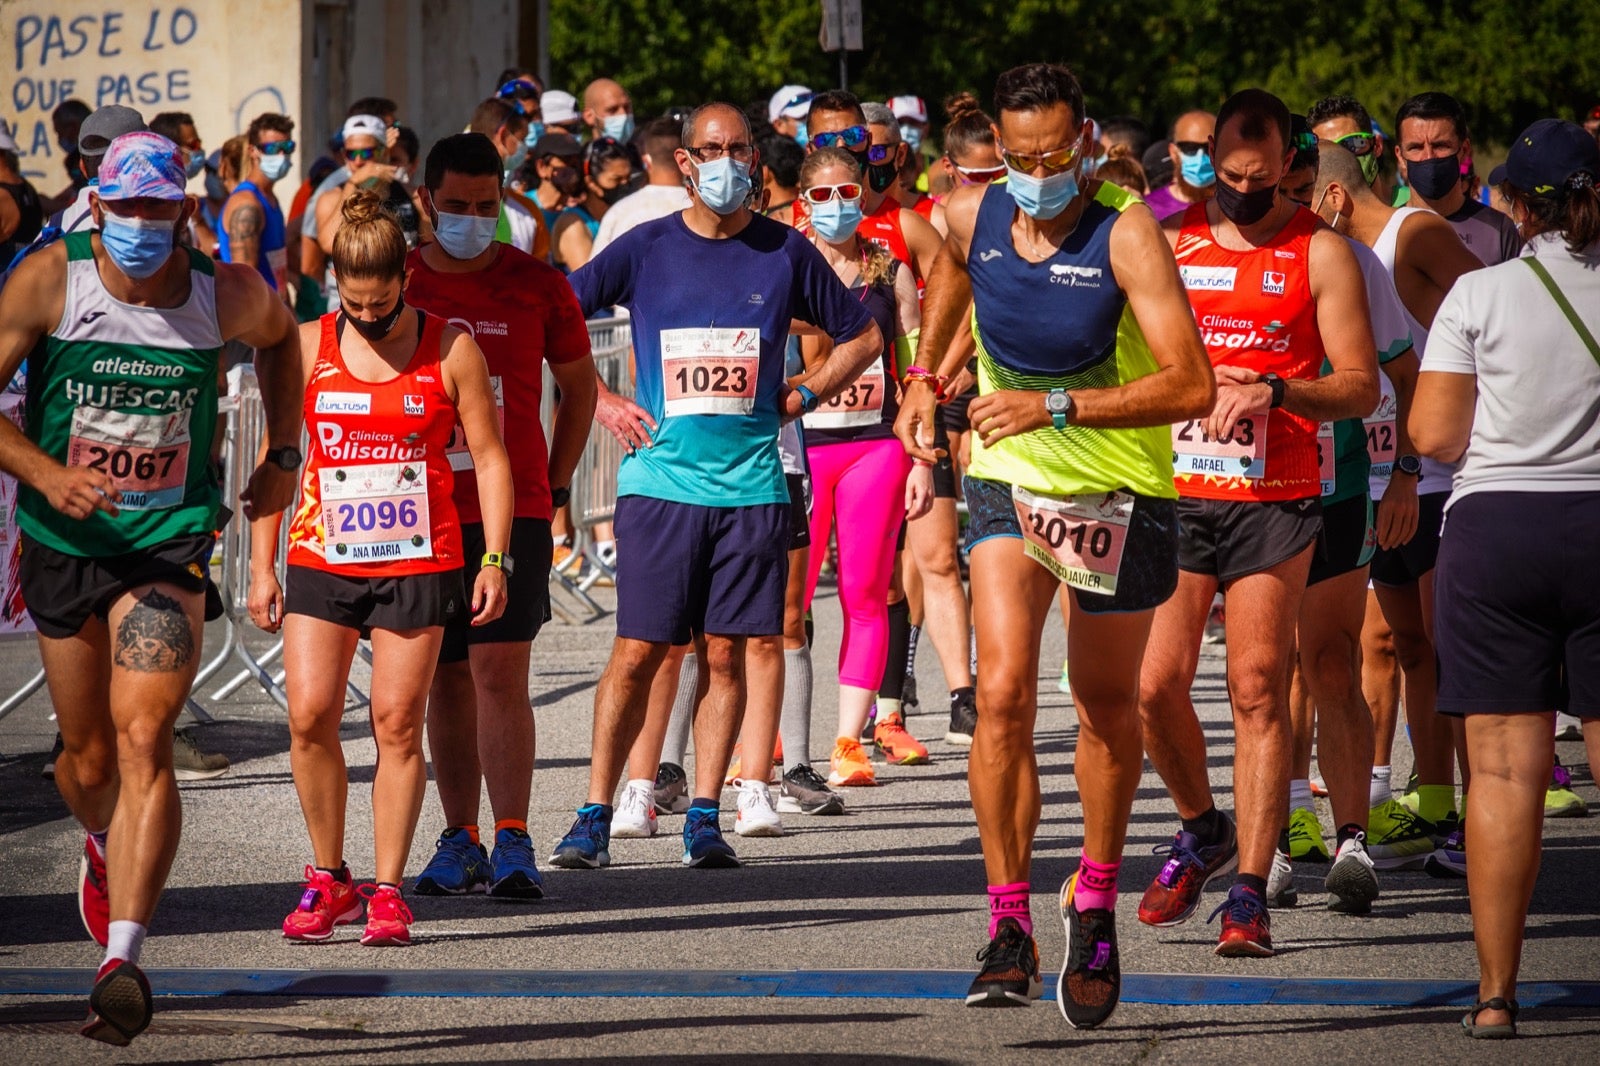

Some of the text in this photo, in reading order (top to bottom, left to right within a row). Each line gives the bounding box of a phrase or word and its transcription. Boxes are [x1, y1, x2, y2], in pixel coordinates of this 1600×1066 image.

[15, 8, 197, 71] PASE LO
[96, 70, 191, 107] PASE
[1050, 275, 1070, 286] CFM
[1263, 284, 1284, 293] MOVE
[1202, 315, 1253, 329] Clínicas
[1199, 327, 1291, 352] lisalud
[92, 356, 184, 378] atletismo
[676, 366, 747, 393] 1023
[66, 378, 199, 411] HUÉSCAR
[404, 406, 424, 414] MOVE
[316, 421, 427, 461] Polisalud
[349, 431, 395, 442] Clínicas
[88, 446, 179, 481] 2067
[1192, 457, 1226, 472] RAFAEL
[338, 499, 418, 532] 2096
[1028, 512, 1112, 559] 2010
[353, 543, 402, 559] ANA MARIA
[1068, 570, 1101, 589] JAVIER
